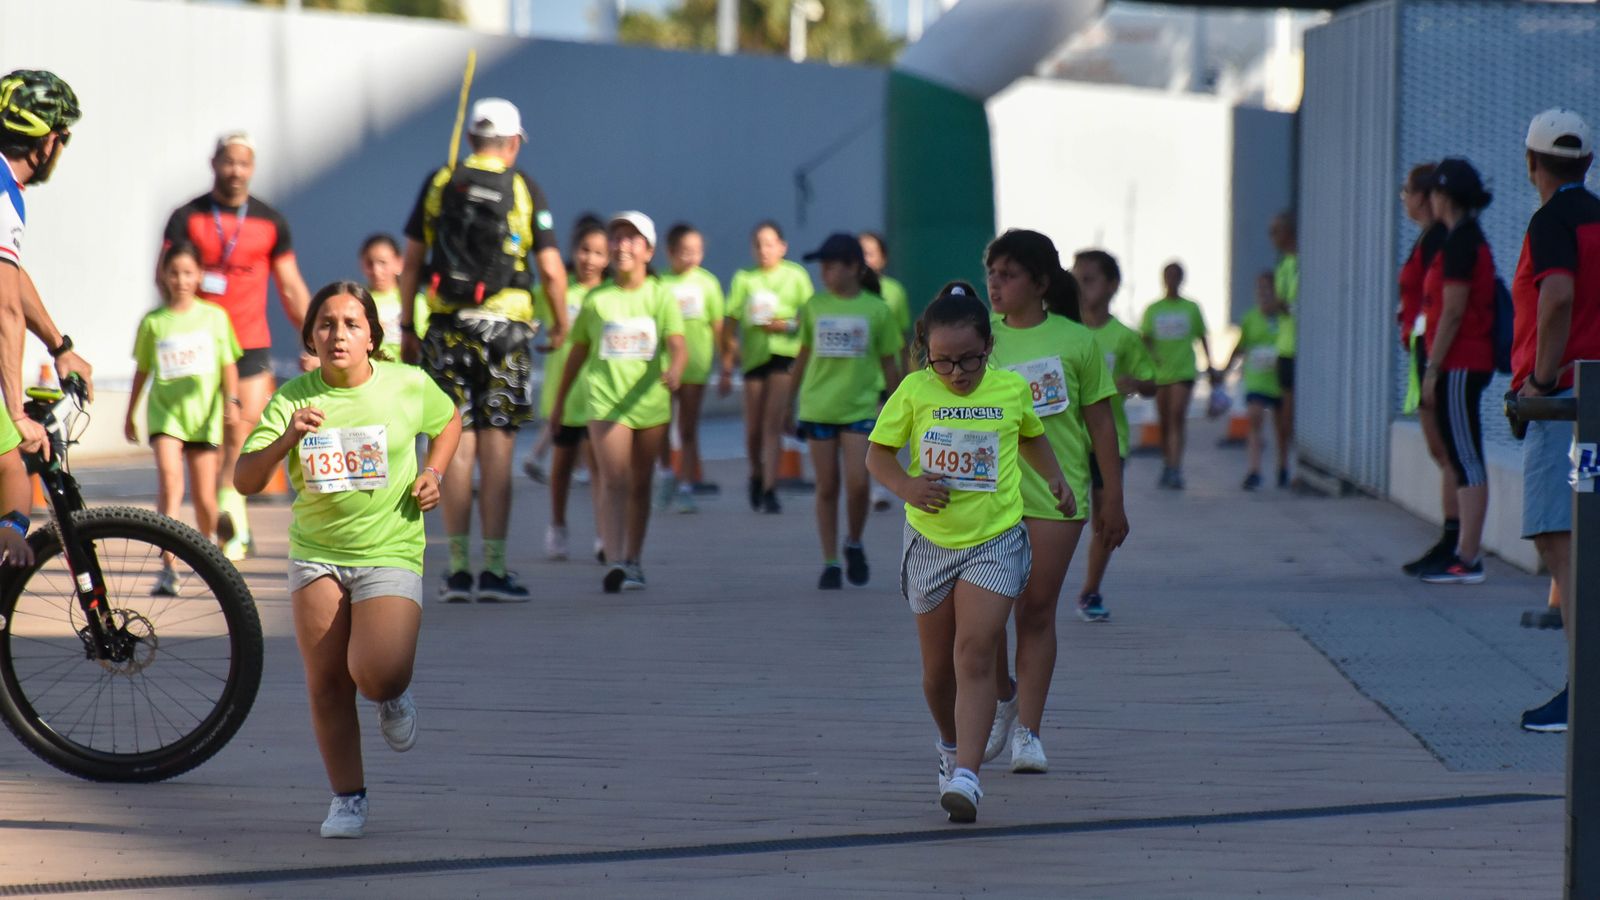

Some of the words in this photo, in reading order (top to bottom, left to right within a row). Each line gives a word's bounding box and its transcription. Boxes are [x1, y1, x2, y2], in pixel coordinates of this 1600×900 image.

[303, 436, 317, 447] XXI
[924, 431, 938, 440] XXI
[306, 450, 358, 476] 1336
[925, 447, 972, 474] 1493
